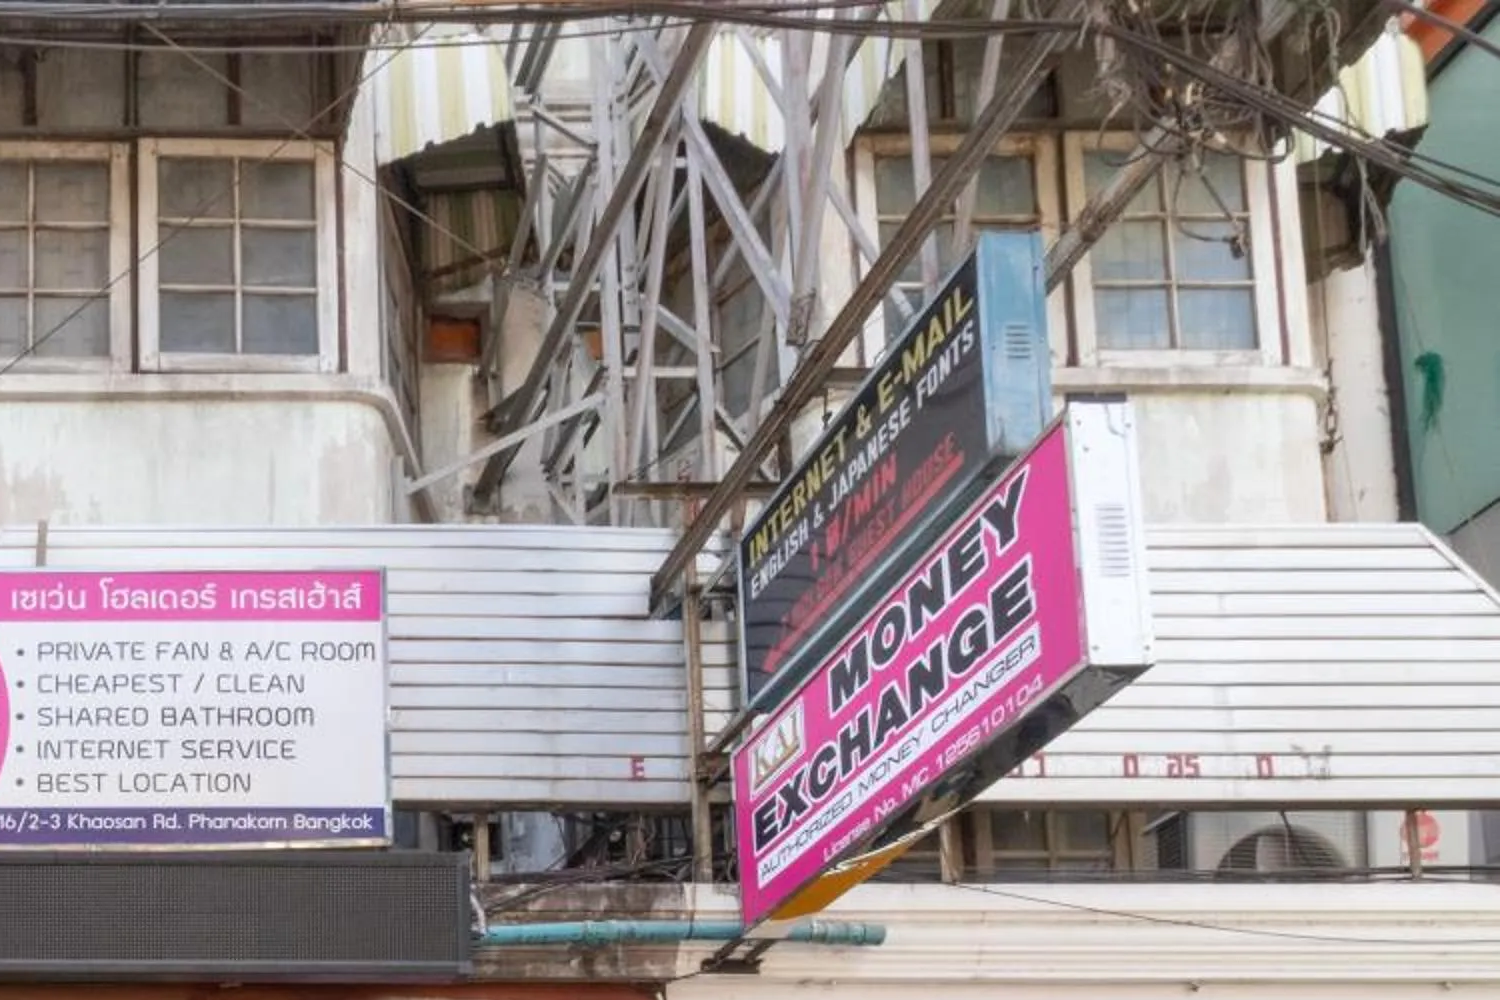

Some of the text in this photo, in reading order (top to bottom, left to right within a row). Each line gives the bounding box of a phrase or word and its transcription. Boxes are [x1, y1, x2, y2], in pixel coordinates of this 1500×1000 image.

[749, 427, 848, 569] INTERNET
[856, 406, 873, 440] &
[877, 285, 973, 407] E-MAIL
[751, 520, 809, 599] ENGLISH
[813, 502, 825, 529] &
[828, 402, 912, 511] JAPANESE
[916, 319, 975, 409] FONTS
[37, 641, 376, 661] PRIVATE FAN & A/C ROOM
[752, 468, 1027, 784] KAI MONEY
[37, 673, 183, 694] CHEAPEST
[216, 673, 305, 694] CLEAN
[754, 560, 1035, 852] EXCHANGE
[37, 706, 315, 727] SHARED BATHROOM
[37, 739, 297, 760] INTERNET SERVICE
[760, 634, 1037, 880] AUTHORIZED MONEY CHANGER
[37, 773, 252, 793] BEST LOCATION
[67, 813, 147, 829] Khaosan
[153, 813, 181, 829] Rd.
[293, 813, 373, 833] Bangkok
[823, 816, 872, 863] License
[874, 795, 899, 822] No.
[901, 766, 930, 799] MC
